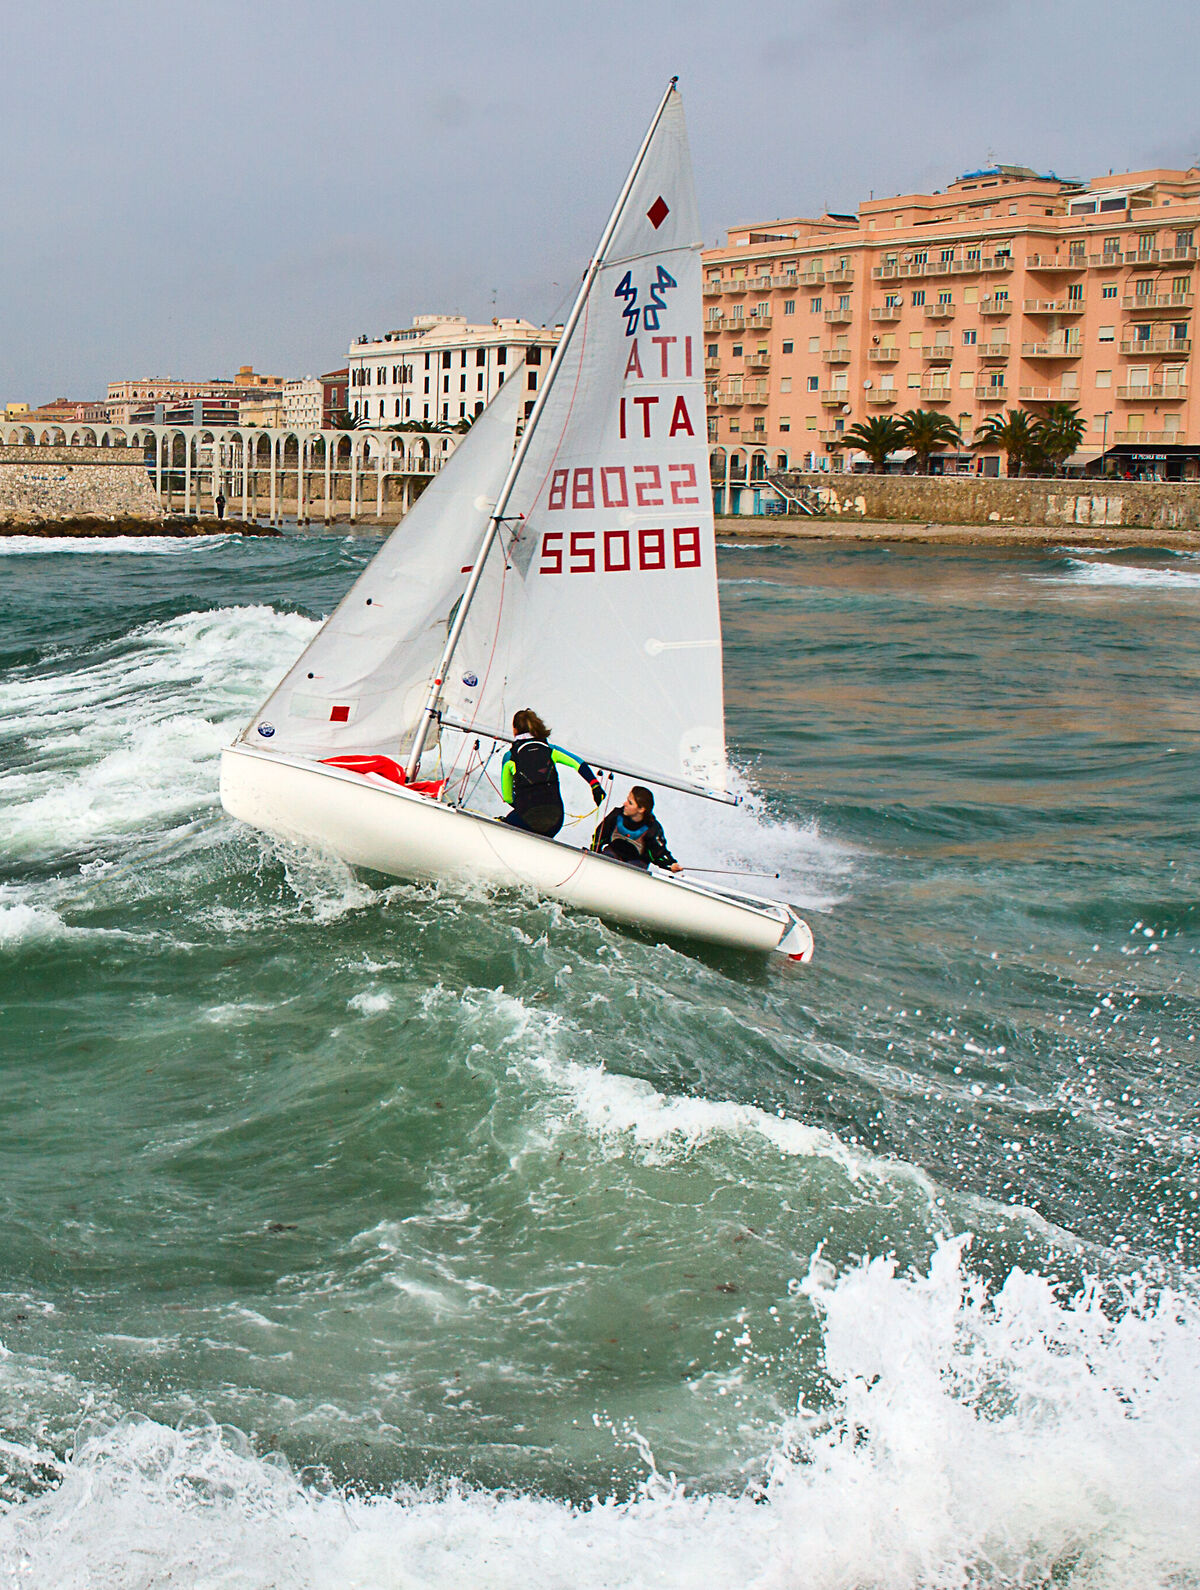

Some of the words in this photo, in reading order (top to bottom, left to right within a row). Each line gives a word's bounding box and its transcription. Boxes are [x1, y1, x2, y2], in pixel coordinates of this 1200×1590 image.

[614, 270, 640, 336] 420
[620, 396, 695, 438] ITA
[540, 527, 701, 574] 55088
